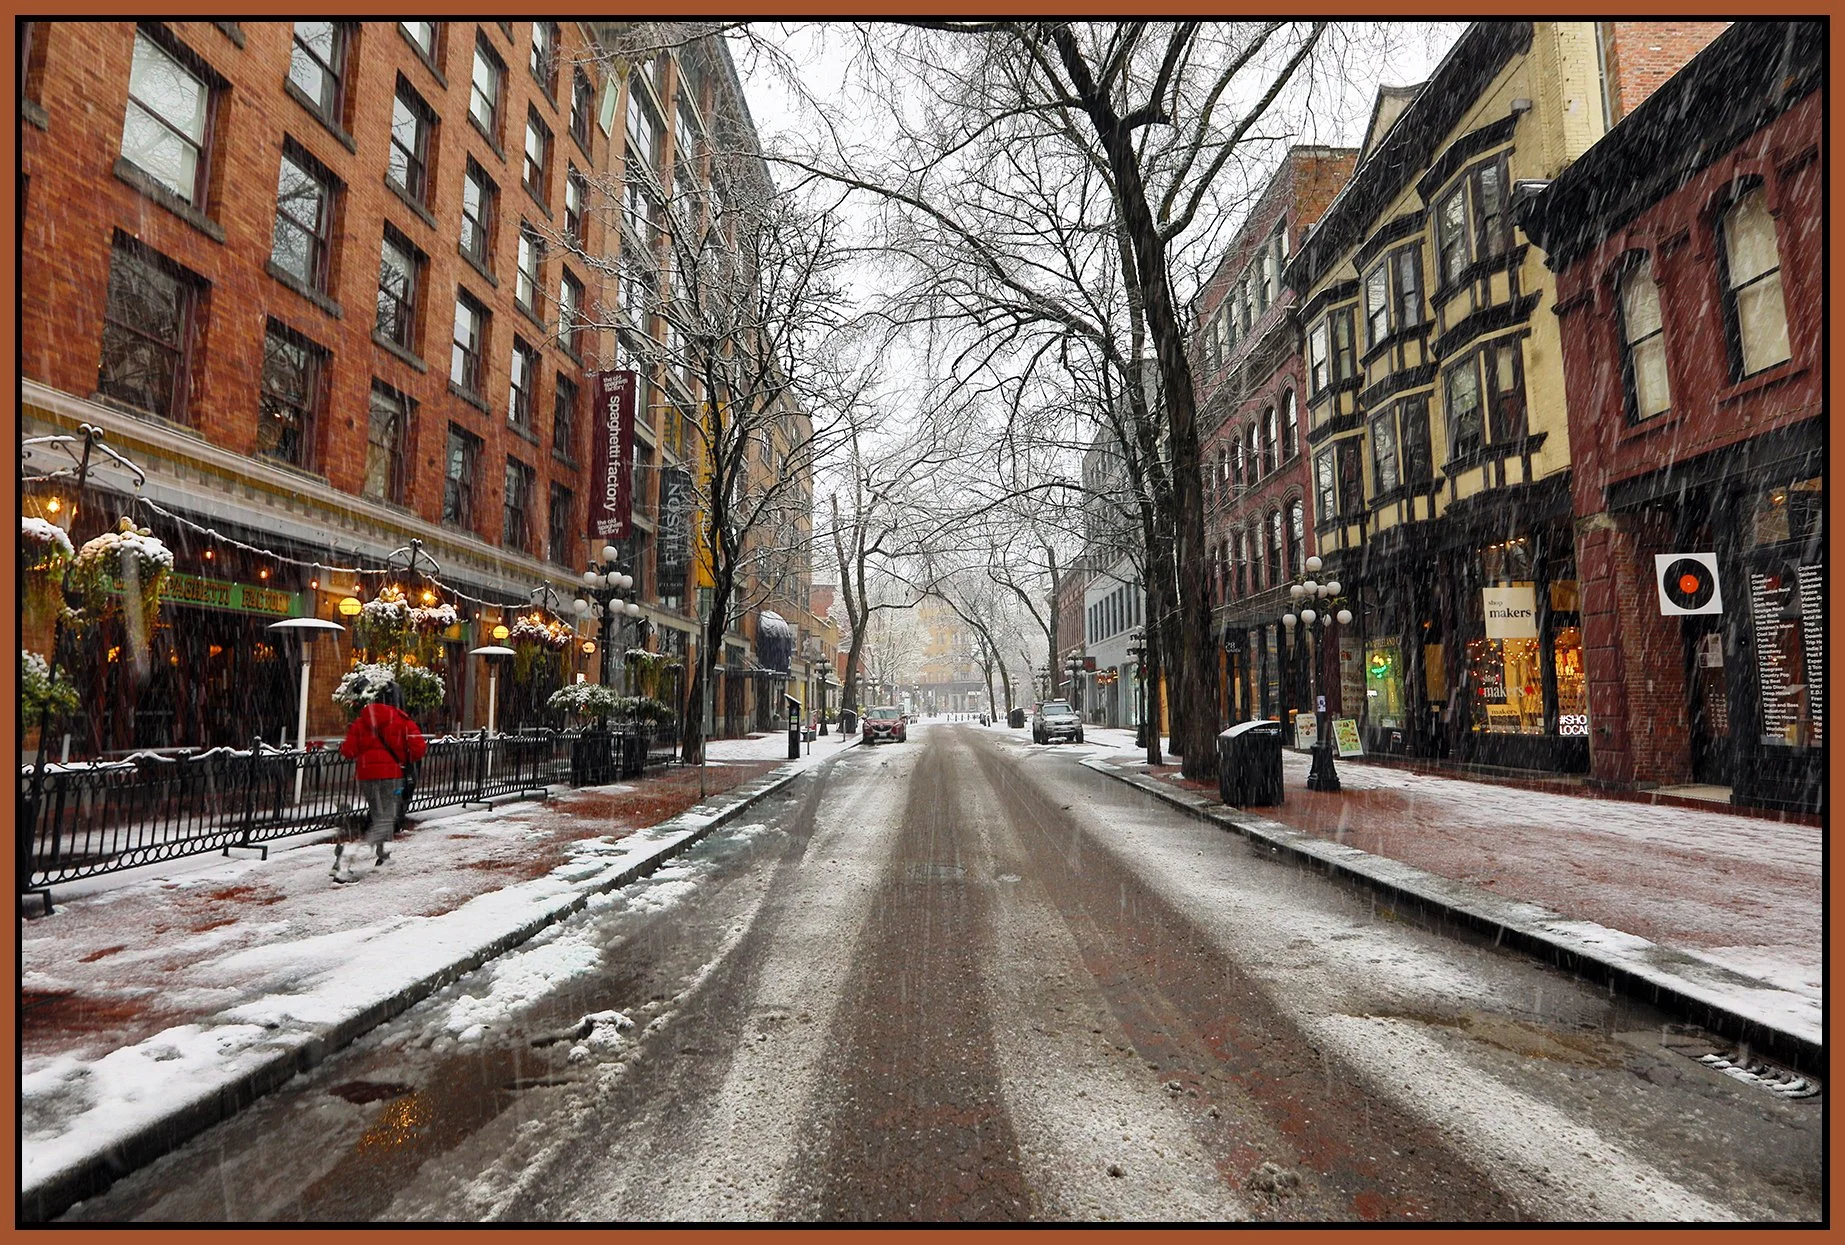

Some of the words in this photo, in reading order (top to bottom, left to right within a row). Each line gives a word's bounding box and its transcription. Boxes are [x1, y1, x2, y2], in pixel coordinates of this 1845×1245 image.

[606, 395, 621, 458] spaghetti
[603, 459, 621, 512] factory
[665, 483, 681, 566] FILSON
[241, 588, 291, 614] FACTORY
[1489, 608, 1532, 618] makers
[1482, 674, 1497, 683] shop
[1483, 683, 1525, 698] makers
[1559, 714, 1588, 725] #SHO
